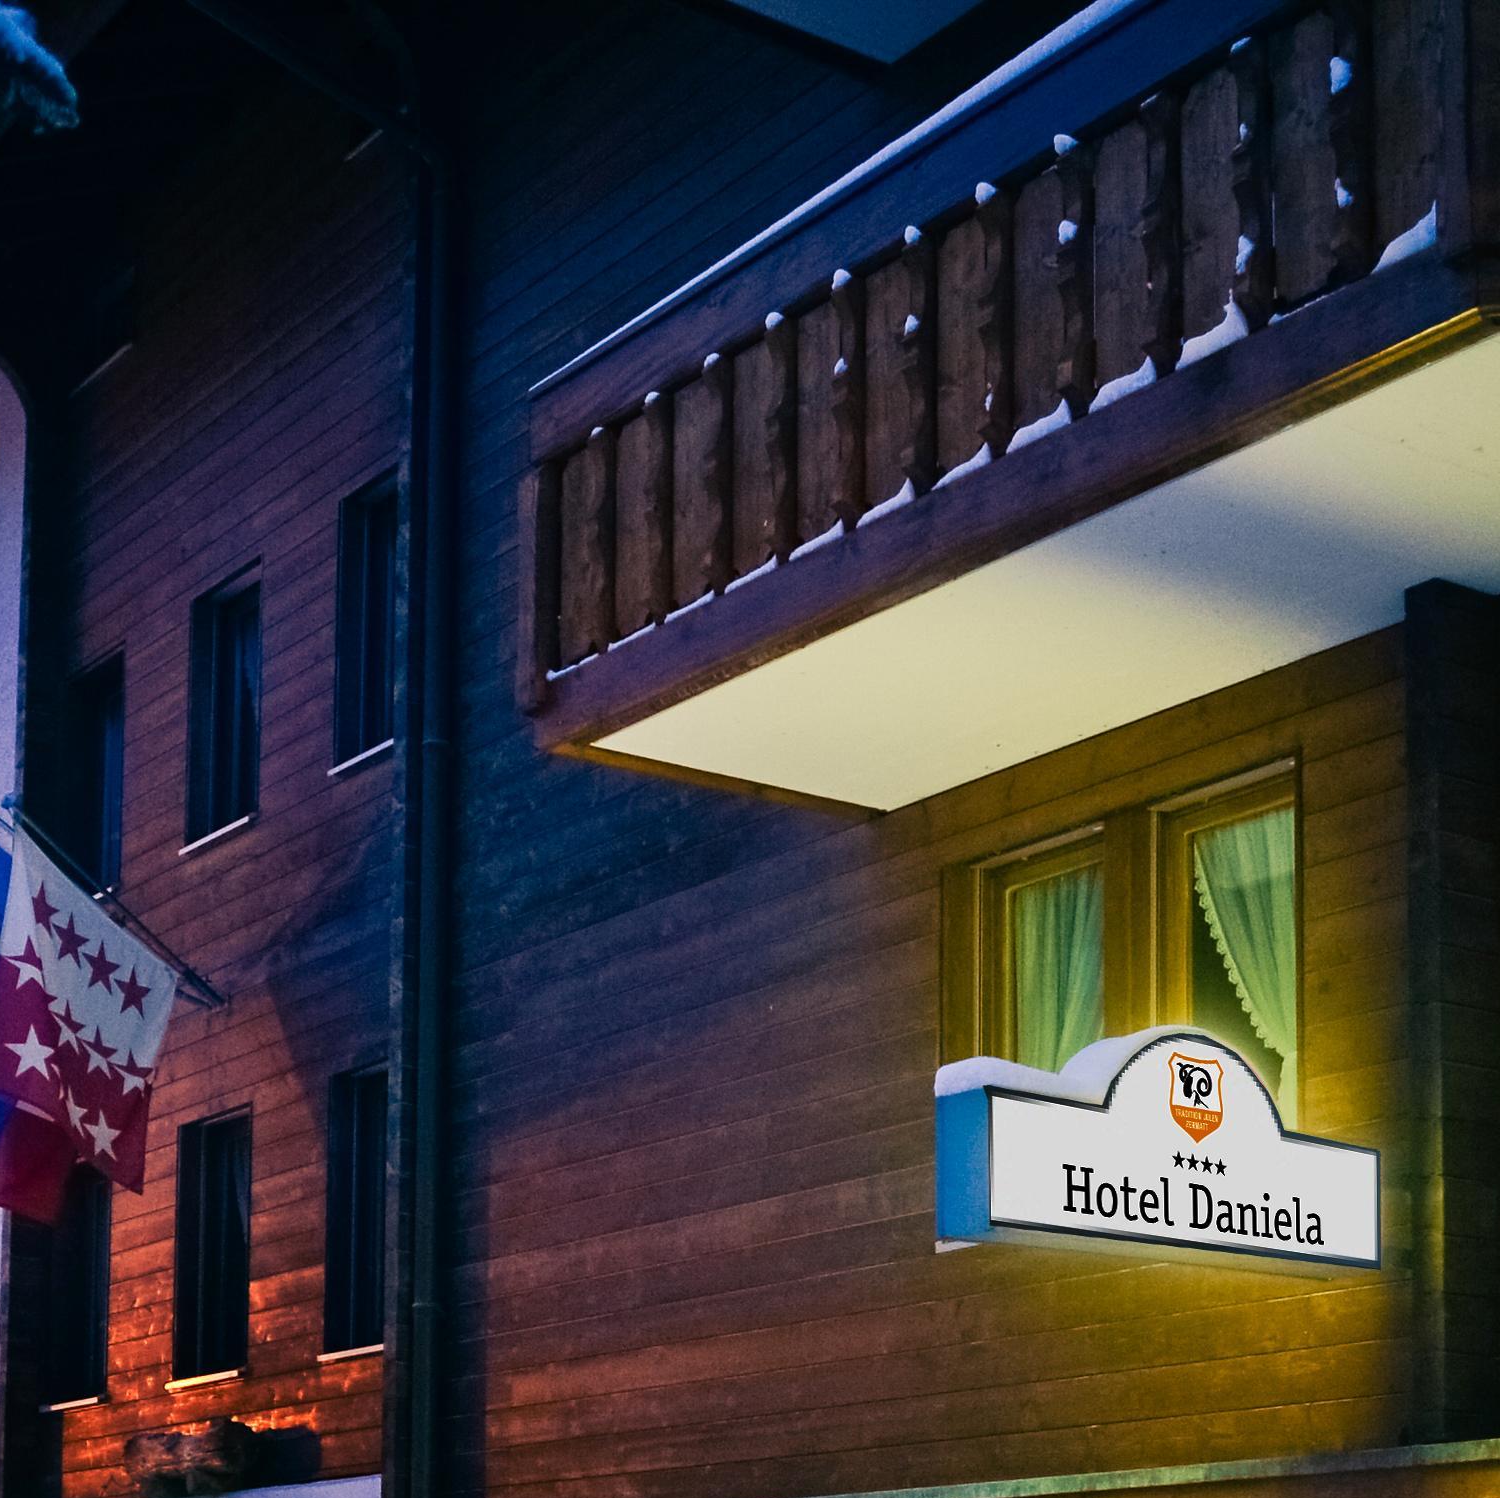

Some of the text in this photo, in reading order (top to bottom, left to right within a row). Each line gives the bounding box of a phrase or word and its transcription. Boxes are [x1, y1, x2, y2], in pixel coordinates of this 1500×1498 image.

[1185, 1120, 1209, 1131] ZERMATT
[1062, 1163, 1325, 1246] Hotel Daniela
